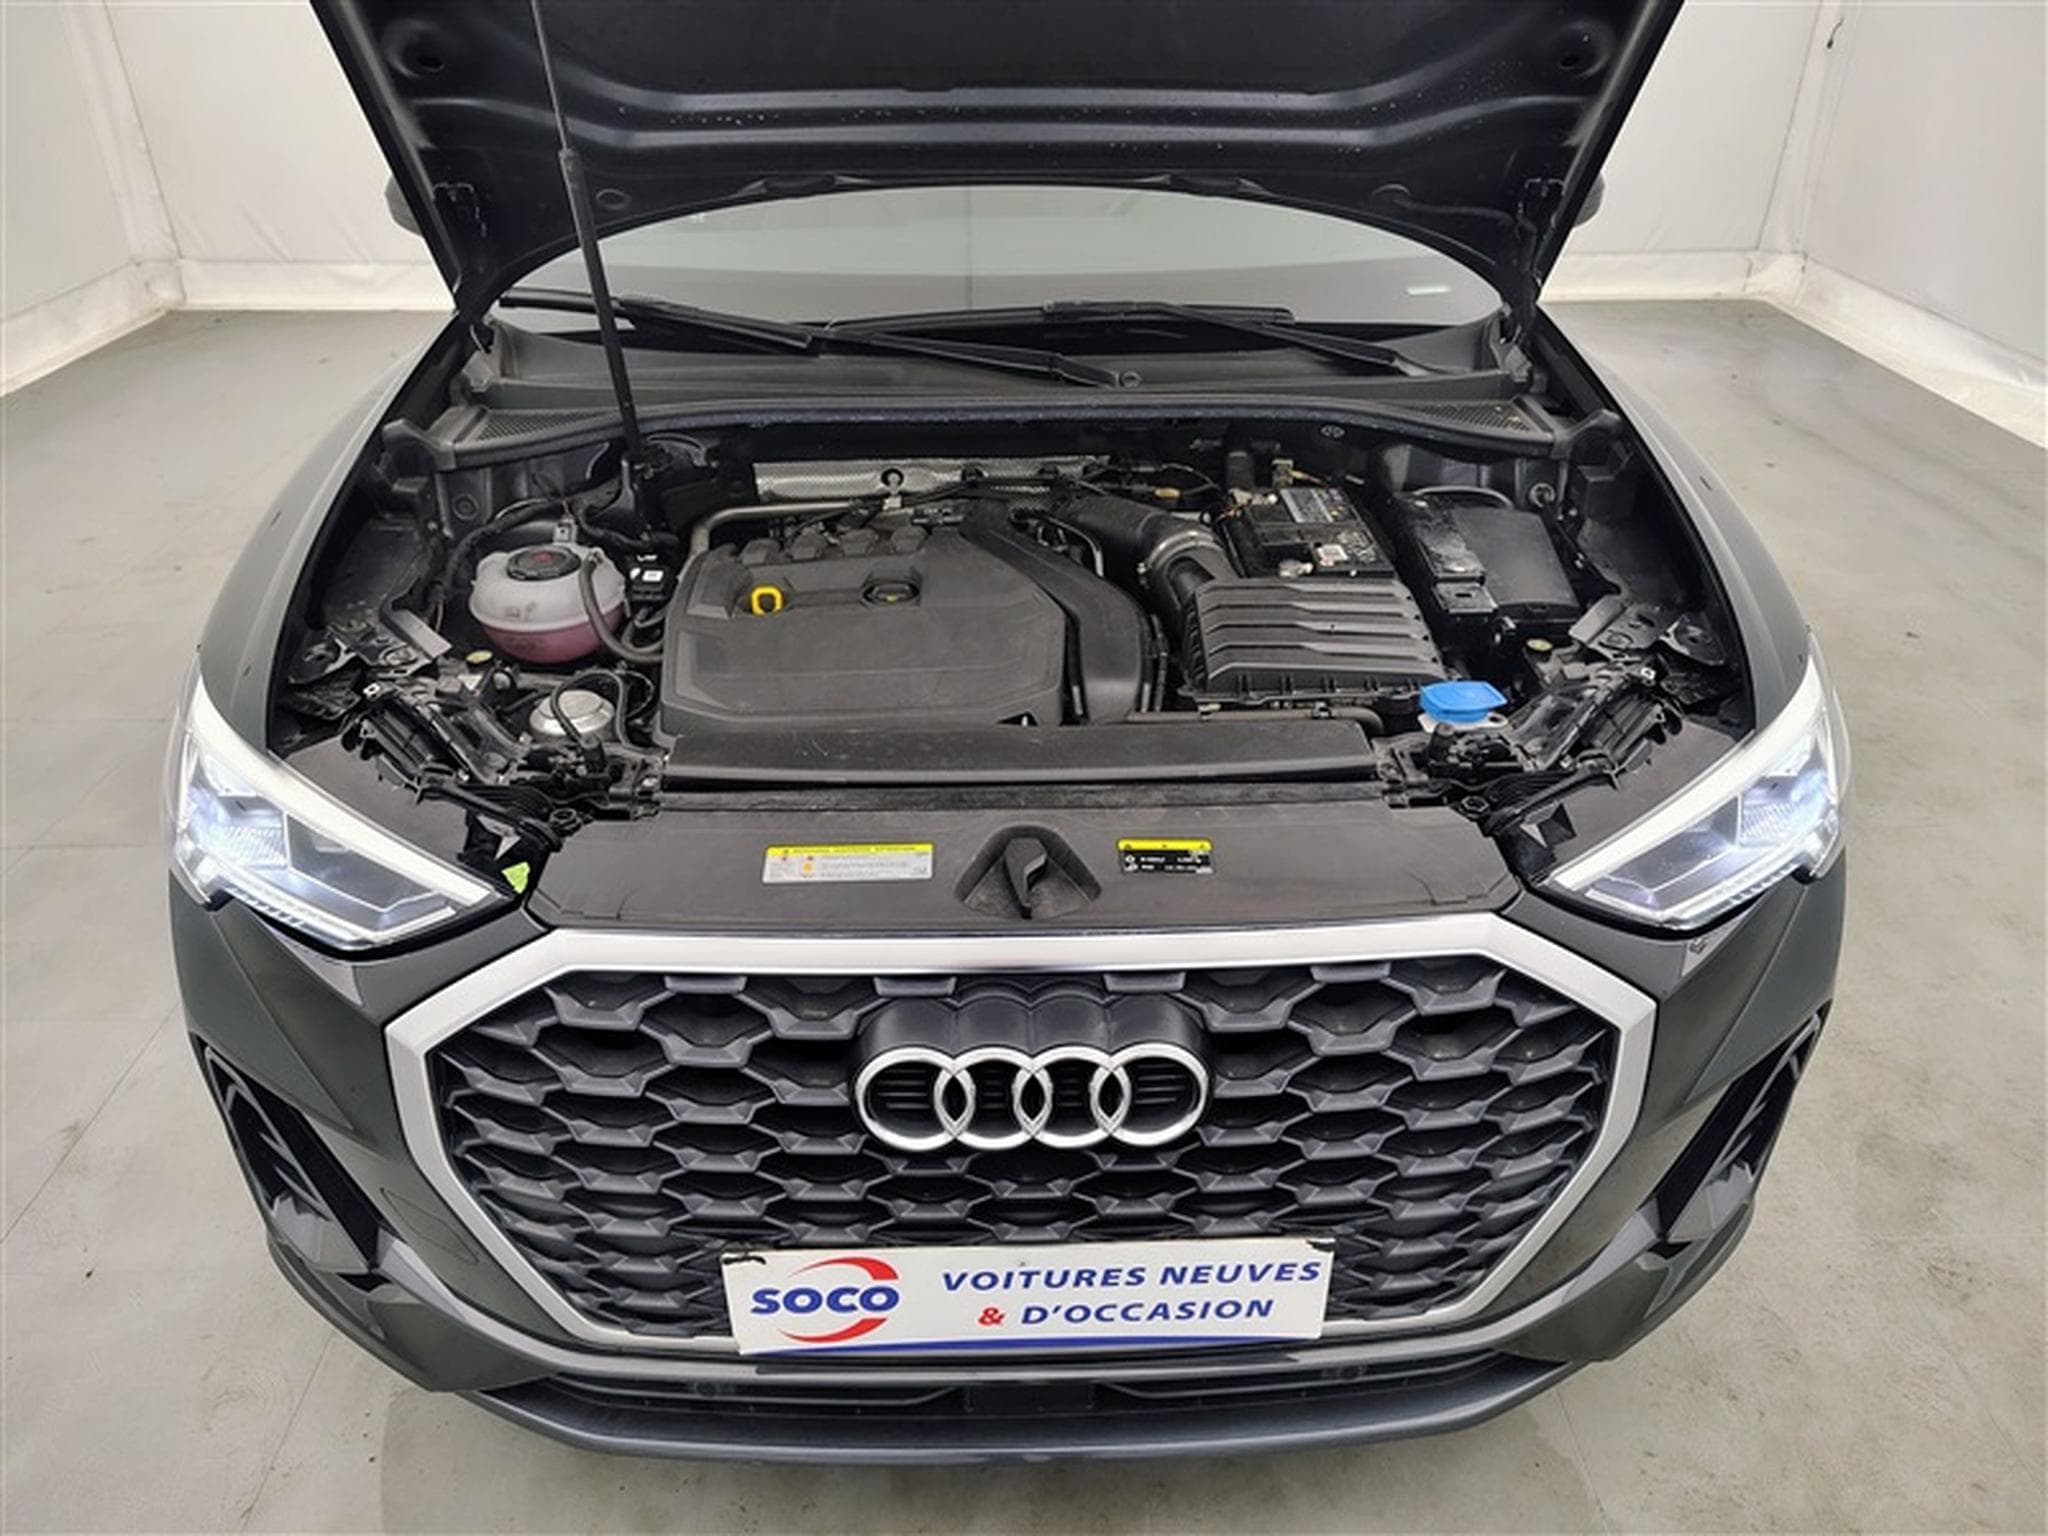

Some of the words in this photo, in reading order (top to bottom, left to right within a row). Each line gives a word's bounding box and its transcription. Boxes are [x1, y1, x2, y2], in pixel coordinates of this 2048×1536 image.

[942, 1267, 1146, 1292] VOITURES
[1159, 1262, 1321, 1286] NEUVES
[750, 1285, 900, 1315] SOCO
[977, 1307, 1006, 1326] &
[1020, 1299, 1274, 1326] D'OCCASION
